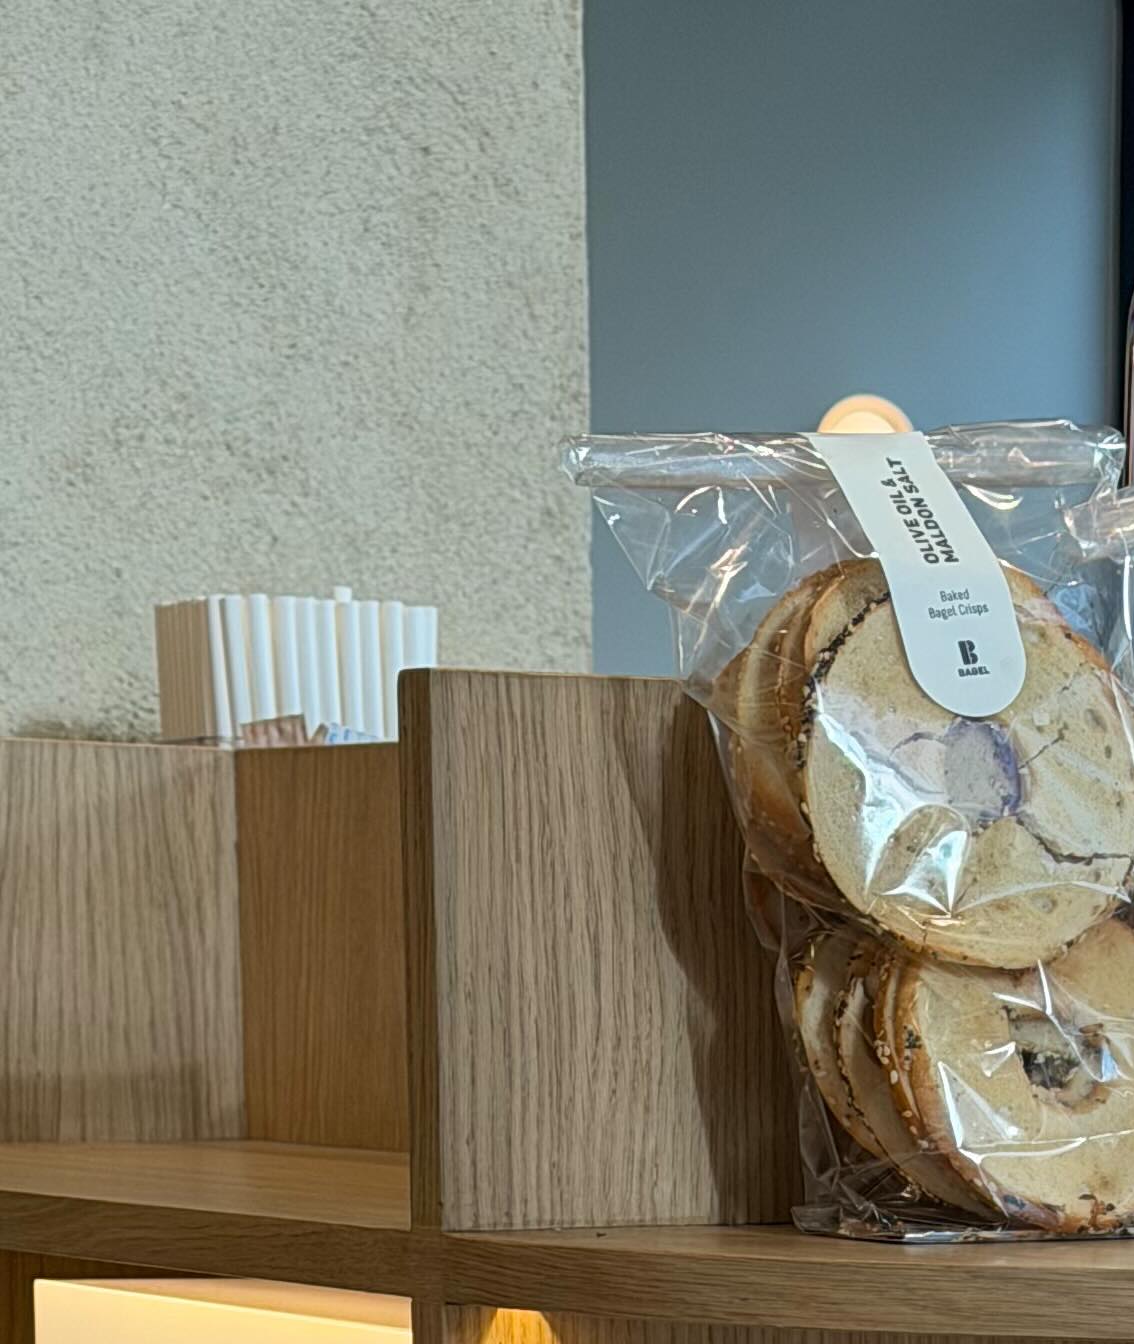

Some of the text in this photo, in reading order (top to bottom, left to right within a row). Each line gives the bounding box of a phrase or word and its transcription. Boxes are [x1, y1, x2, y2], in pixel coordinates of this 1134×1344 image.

[881, 479, 940, 564] OLIVE OIL &
[886, 457, 959, 562] MALDON SALT
[940, 588, 970, 602] Baked
[928, 603, 989, 620] Bagel Crisps
[958, 640, 979, 665] B
